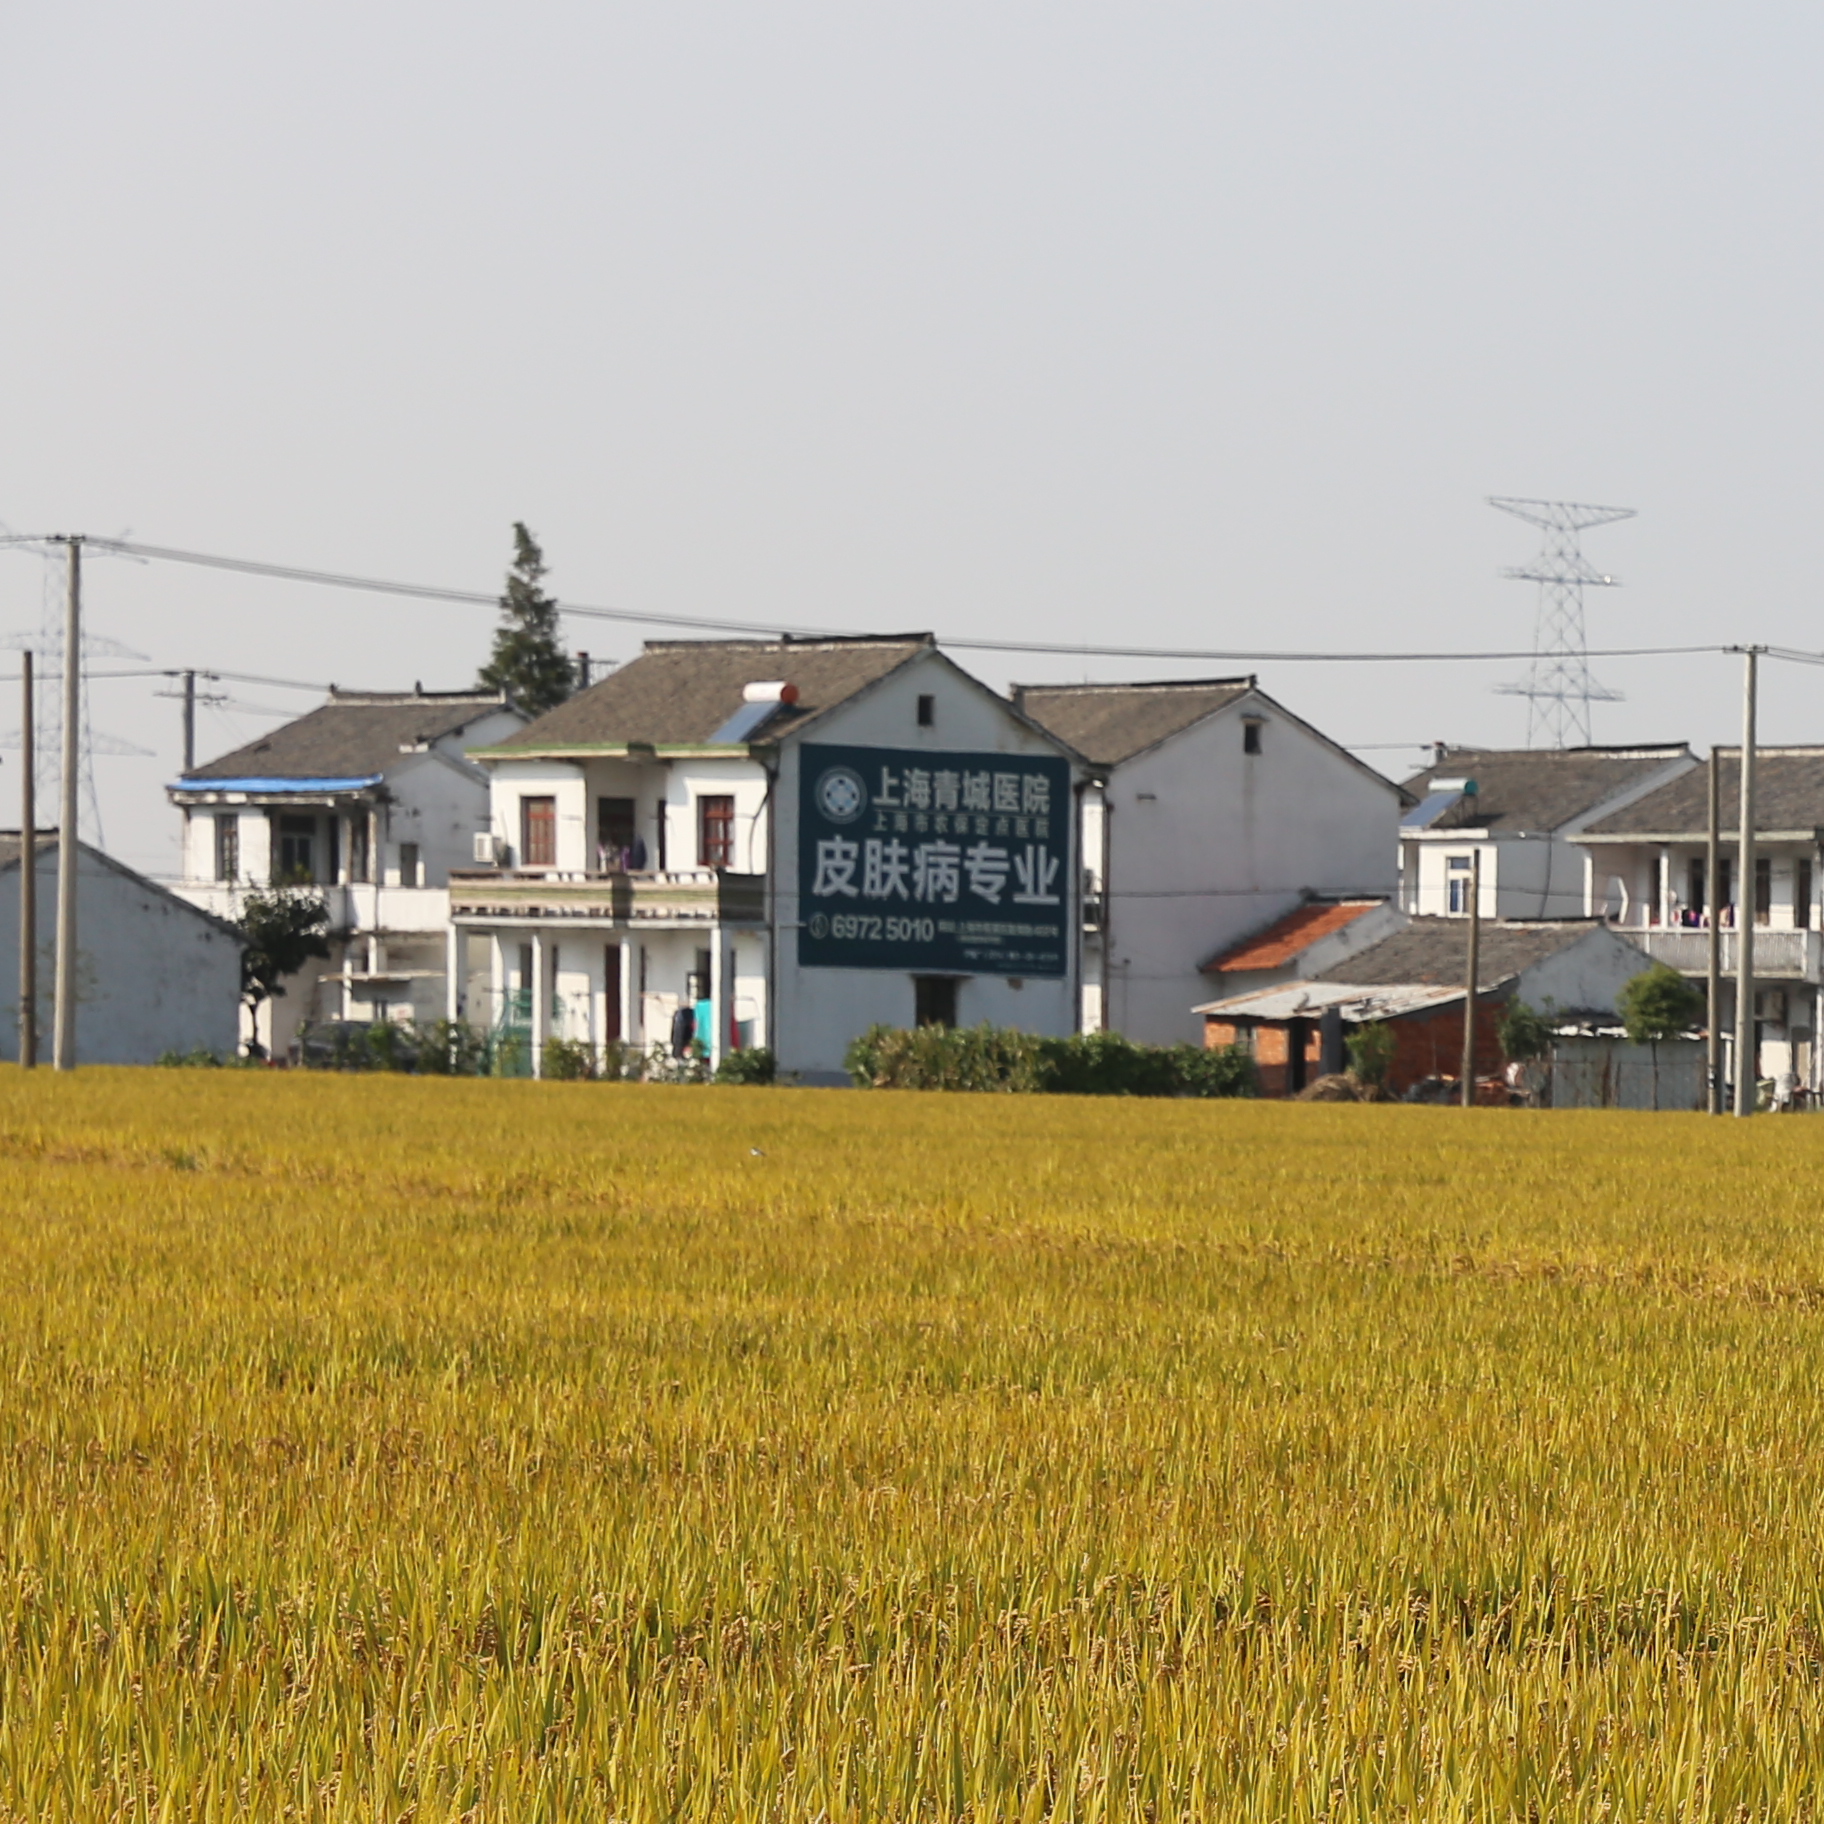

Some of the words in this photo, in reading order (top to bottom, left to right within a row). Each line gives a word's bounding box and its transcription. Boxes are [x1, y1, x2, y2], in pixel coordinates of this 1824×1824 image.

[872, 766, 1051, 813] 上海青城医院
[812, 835, 1061, 905] 皮肤病专业
[832, 913, 883, 941] 6972
[885, 916, 935, 942] 5010
